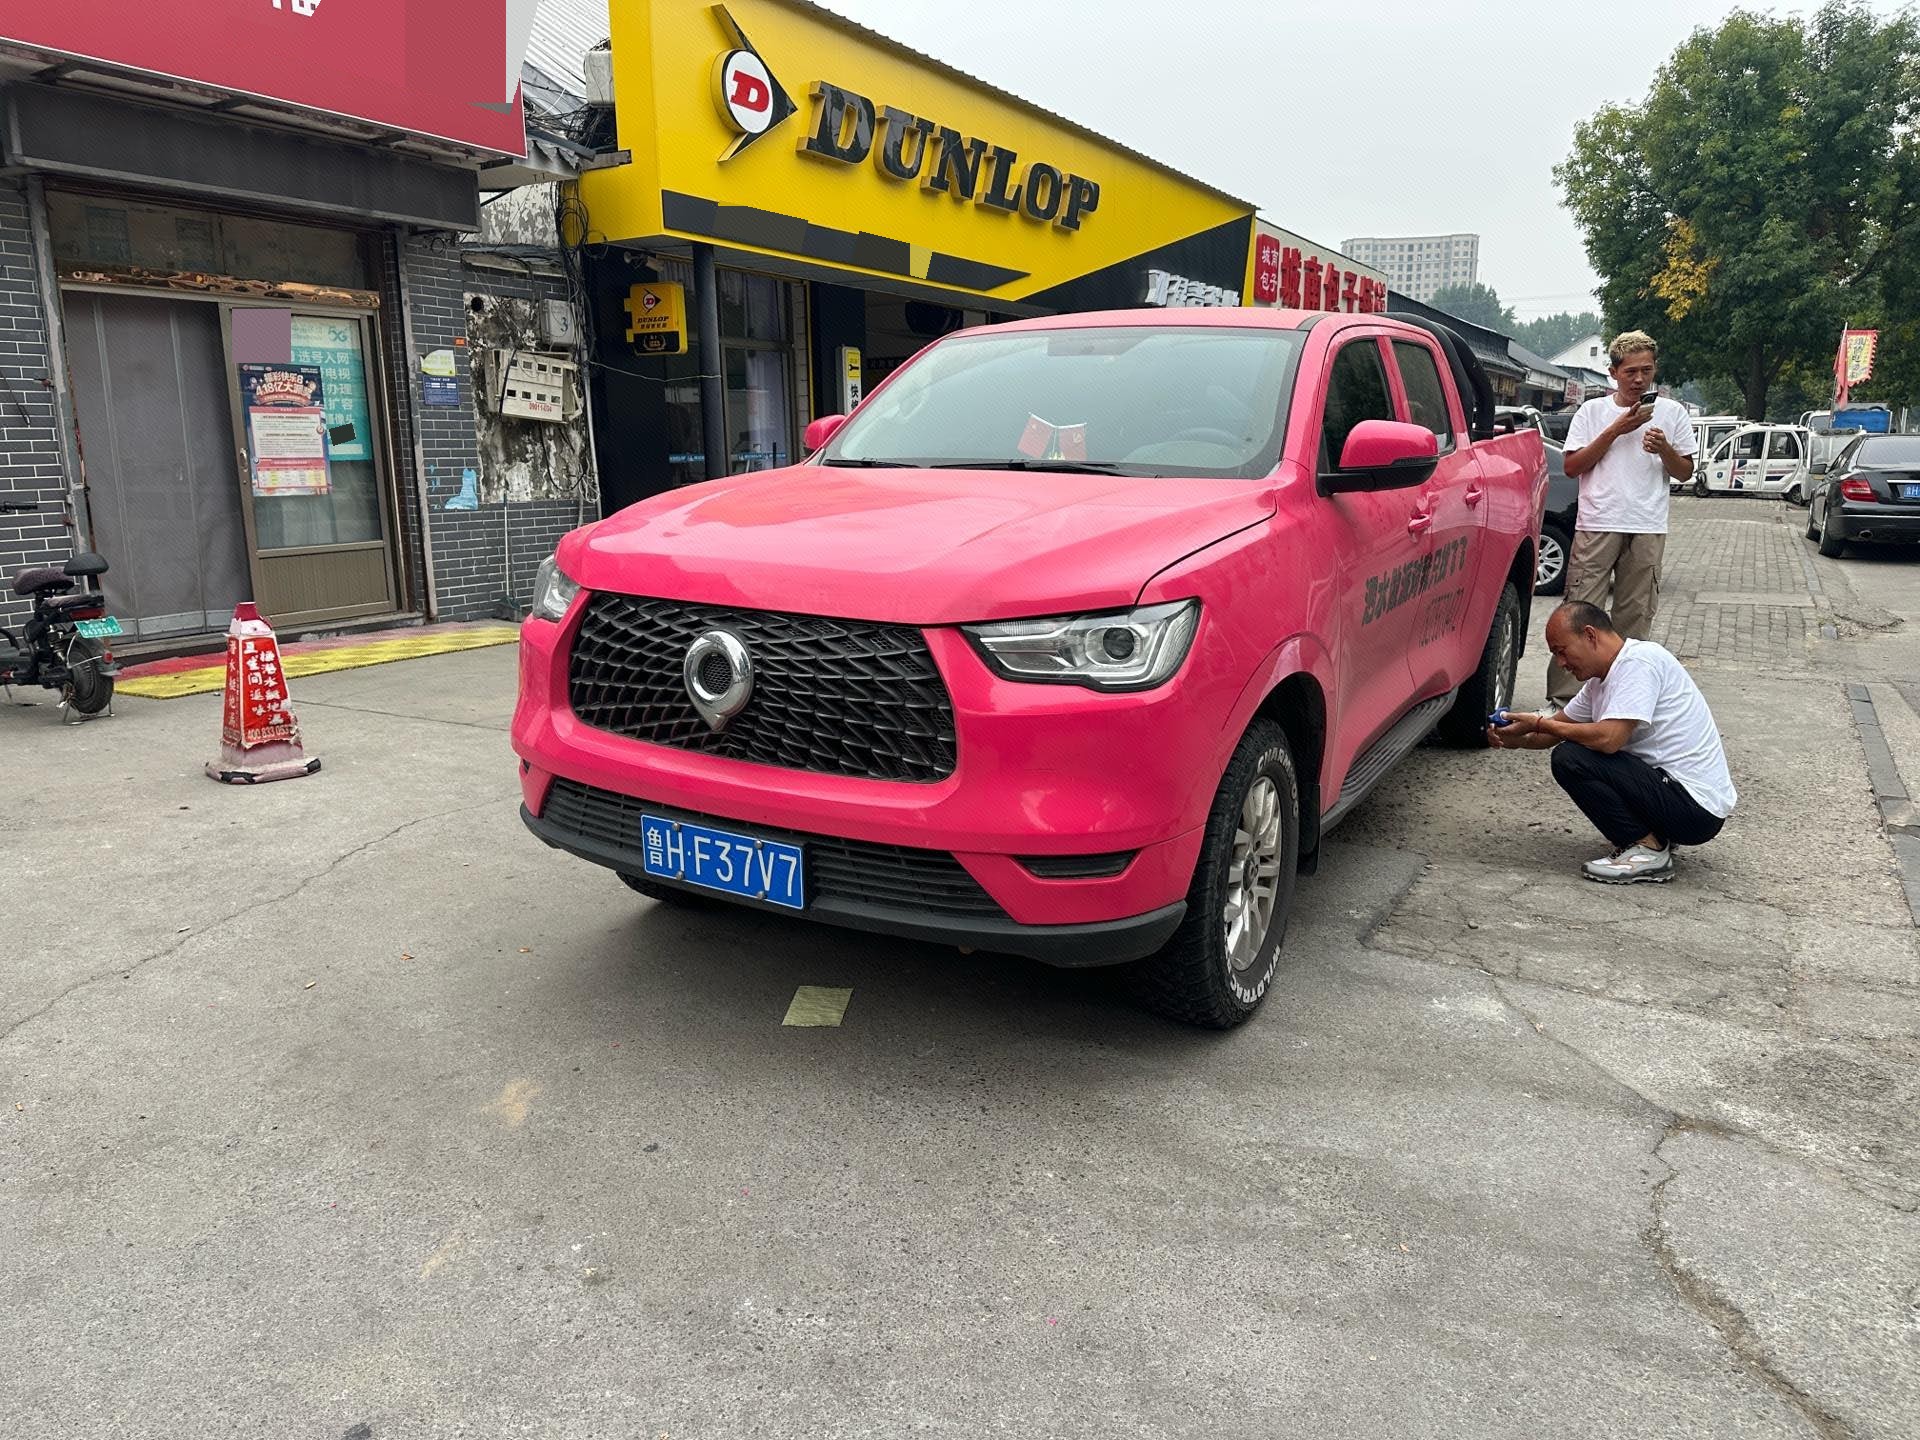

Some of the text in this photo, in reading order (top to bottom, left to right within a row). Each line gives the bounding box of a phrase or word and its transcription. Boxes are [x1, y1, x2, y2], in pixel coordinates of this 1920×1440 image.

[730, 69, 770, 113] D
[797, 80, 1101, 232] DUNLOP
[637, 315, 670, 324] DUNLOP
[646, 826, 798, 898] 鲁H·F37V7
